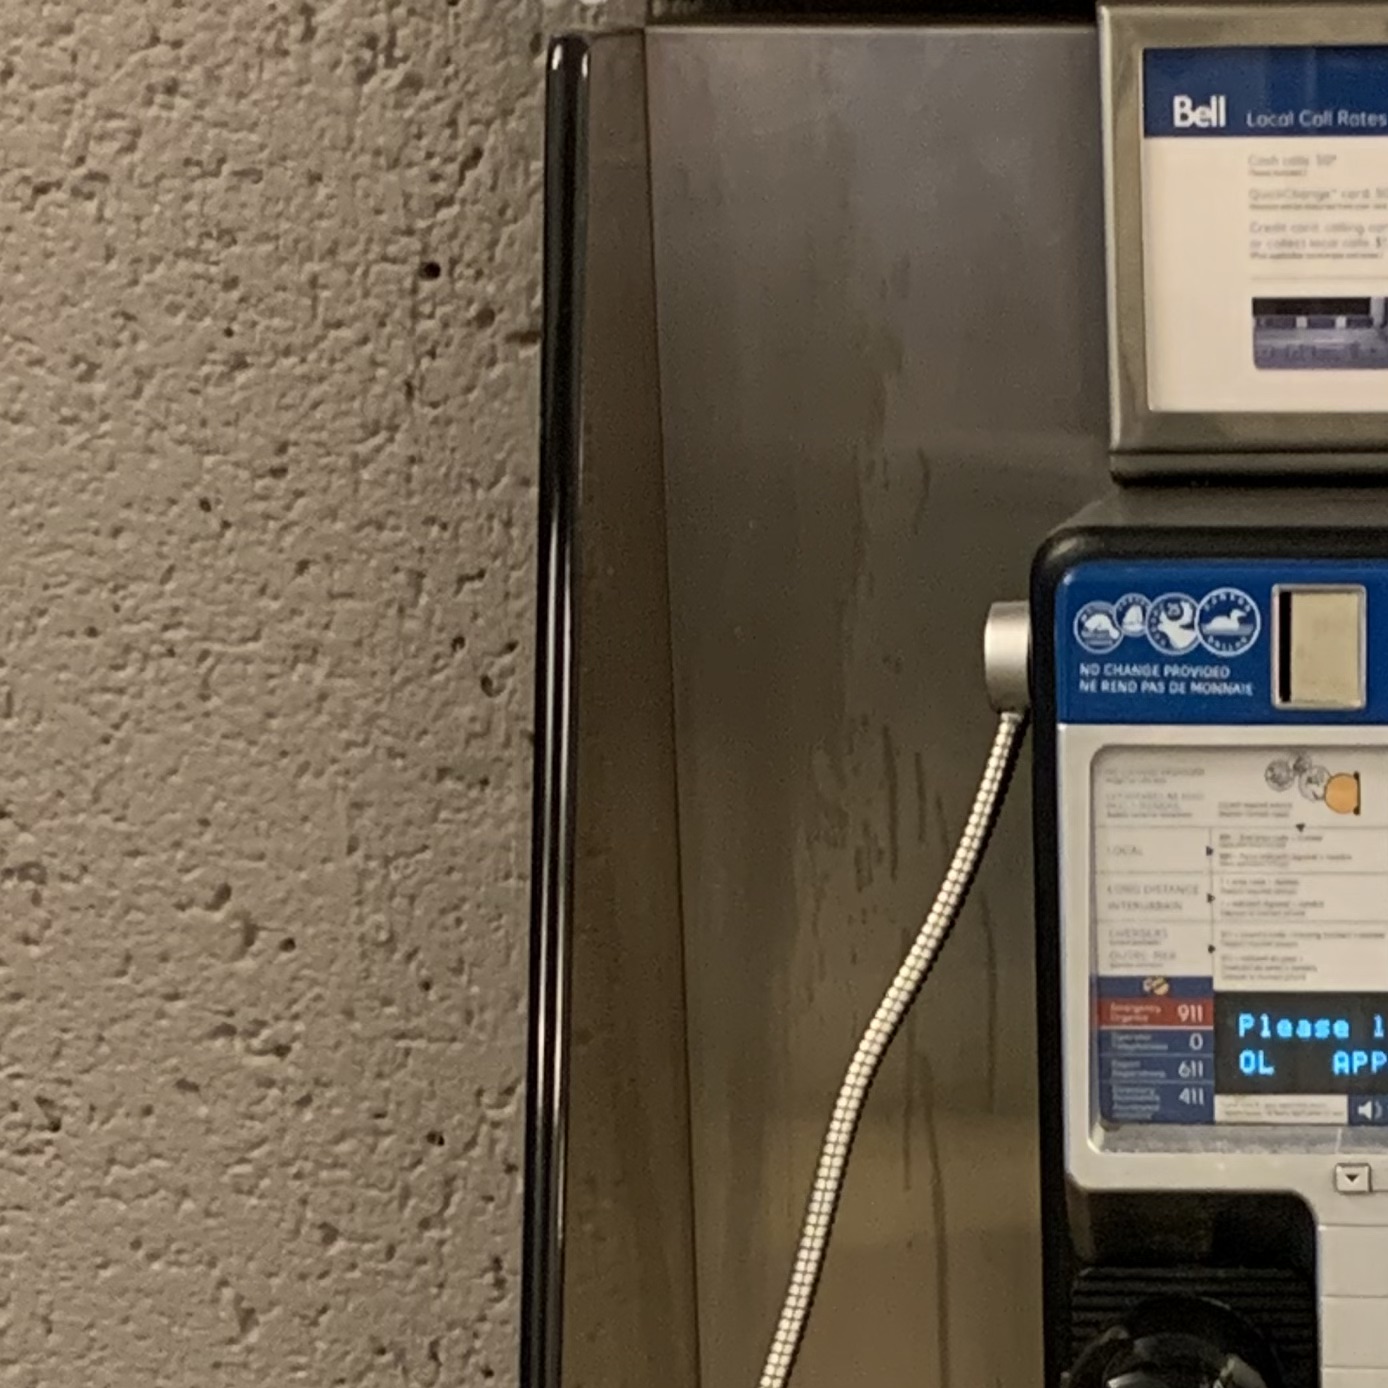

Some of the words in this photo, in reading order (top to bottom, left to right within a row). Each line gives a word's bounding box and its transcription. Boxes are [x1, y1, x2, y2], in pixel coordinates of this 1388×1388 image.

[1173, 95, 1226, 128] Bell
[1247, 110, 1294, 127] Local
[1300, 110, 1332, 127] Call
[1337, 110, 1388, 127] Rates
[1080, 663, 1100, 676] NO
[1104, 663, 1160, 677] CHANGE
[1164, 664, 1231, 677] PROVIDED
[1079, 680, 1098, 693] NE
[1101, 680, 1138, 693] REND
[1141, 680, 1166, 694] PAS
[1169, 681, 1187, 694] DE
[1190, 682, 1254, 696] MONNAIE
[1177, 1004, 1203, 1022] 911
[1238, 1013, 1350, 1038] Please
[1189, 1033, 1203, 1050] 0
[1178, 1060, 1203, 1078] 611
[1179, 1088, 1204, 1105] 411
